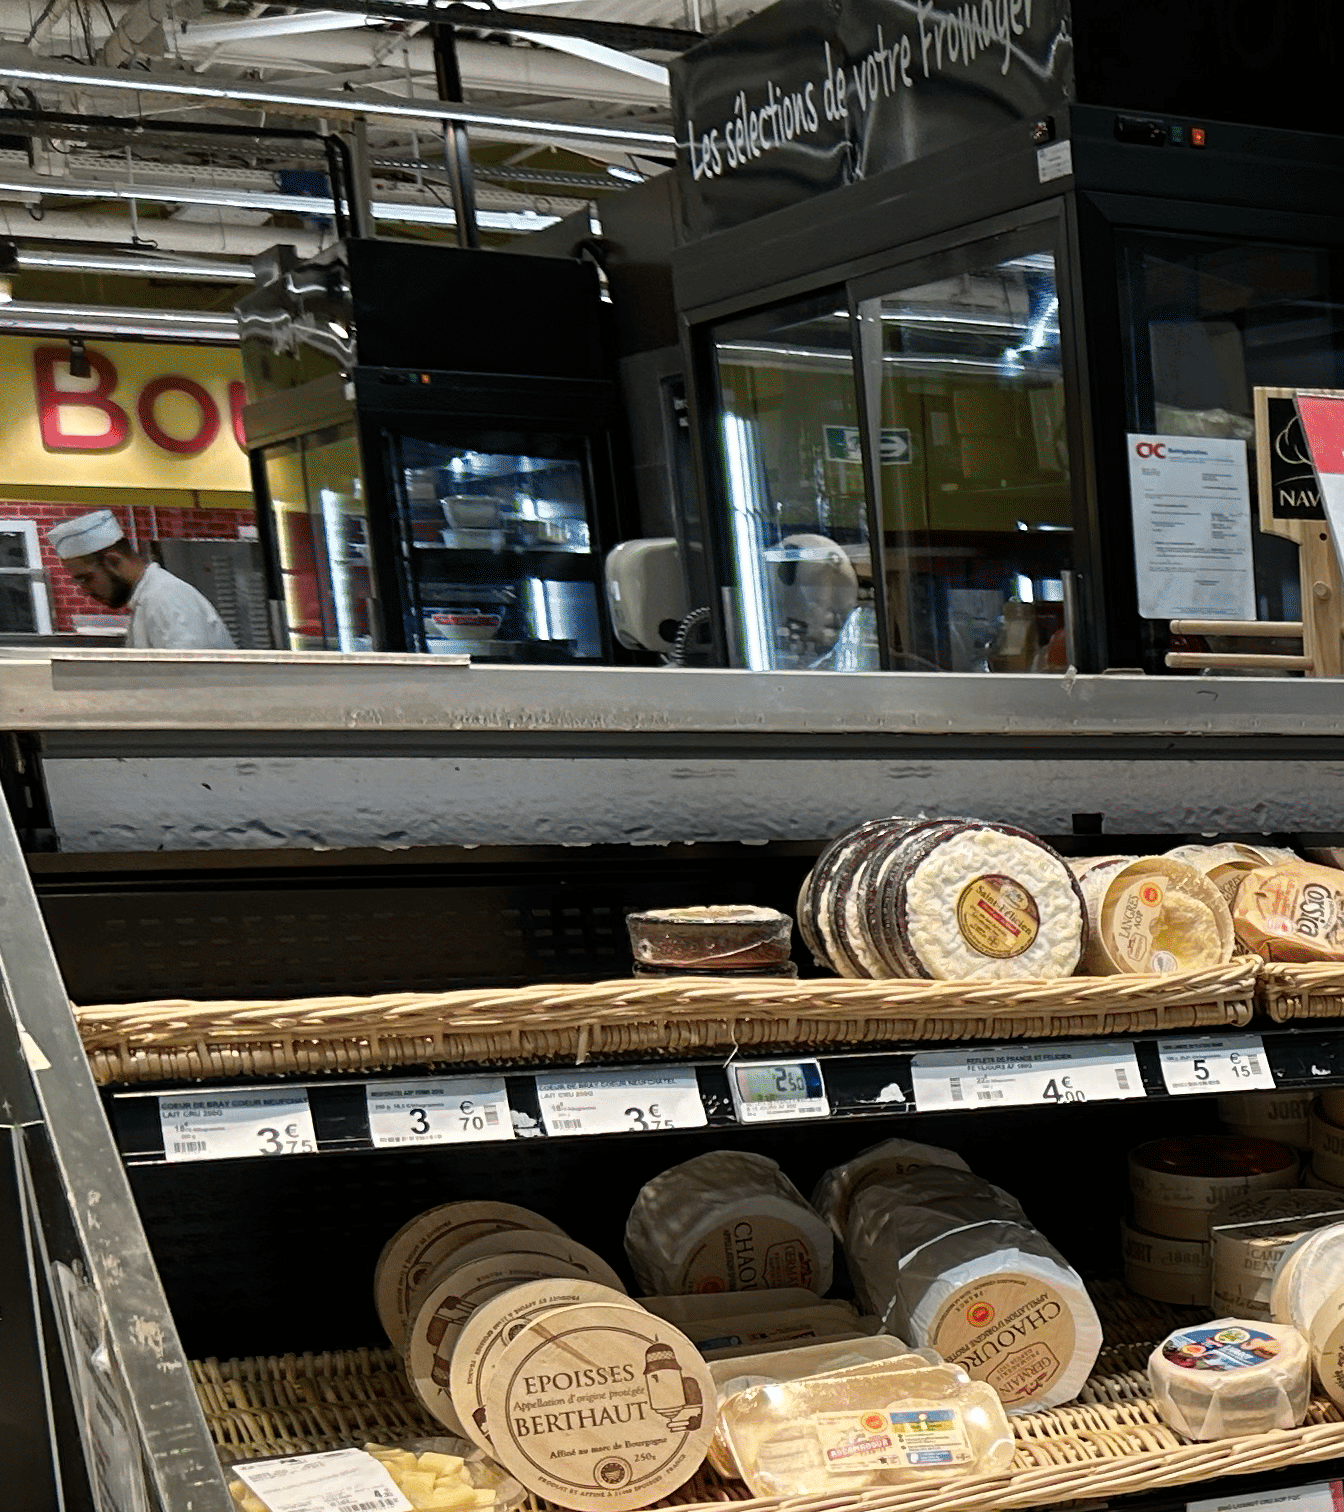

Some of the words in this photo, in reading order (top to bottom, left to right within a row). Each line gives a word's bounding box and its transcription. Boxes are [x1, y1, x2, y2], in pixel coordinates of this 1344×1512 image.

[687, 120, 722, 181] Les
[725, 81, 819, 168] sélections
[824, 40, 848, 121] de
[853, 24, 913, 111] votre
[1118, 894, 1139, 940] LANGRES
[1295, 882, 1331, 939] Corsica
[523, 1363, 636, 1397] EPOISSES
[513, 1395, 566, 1413] Appellation
[513, 1401, 650, 1438] BERTHAUT
[549, 1446, 576, 1460] Affiné
[624, 1436, 668, 1454] Bourgogne
